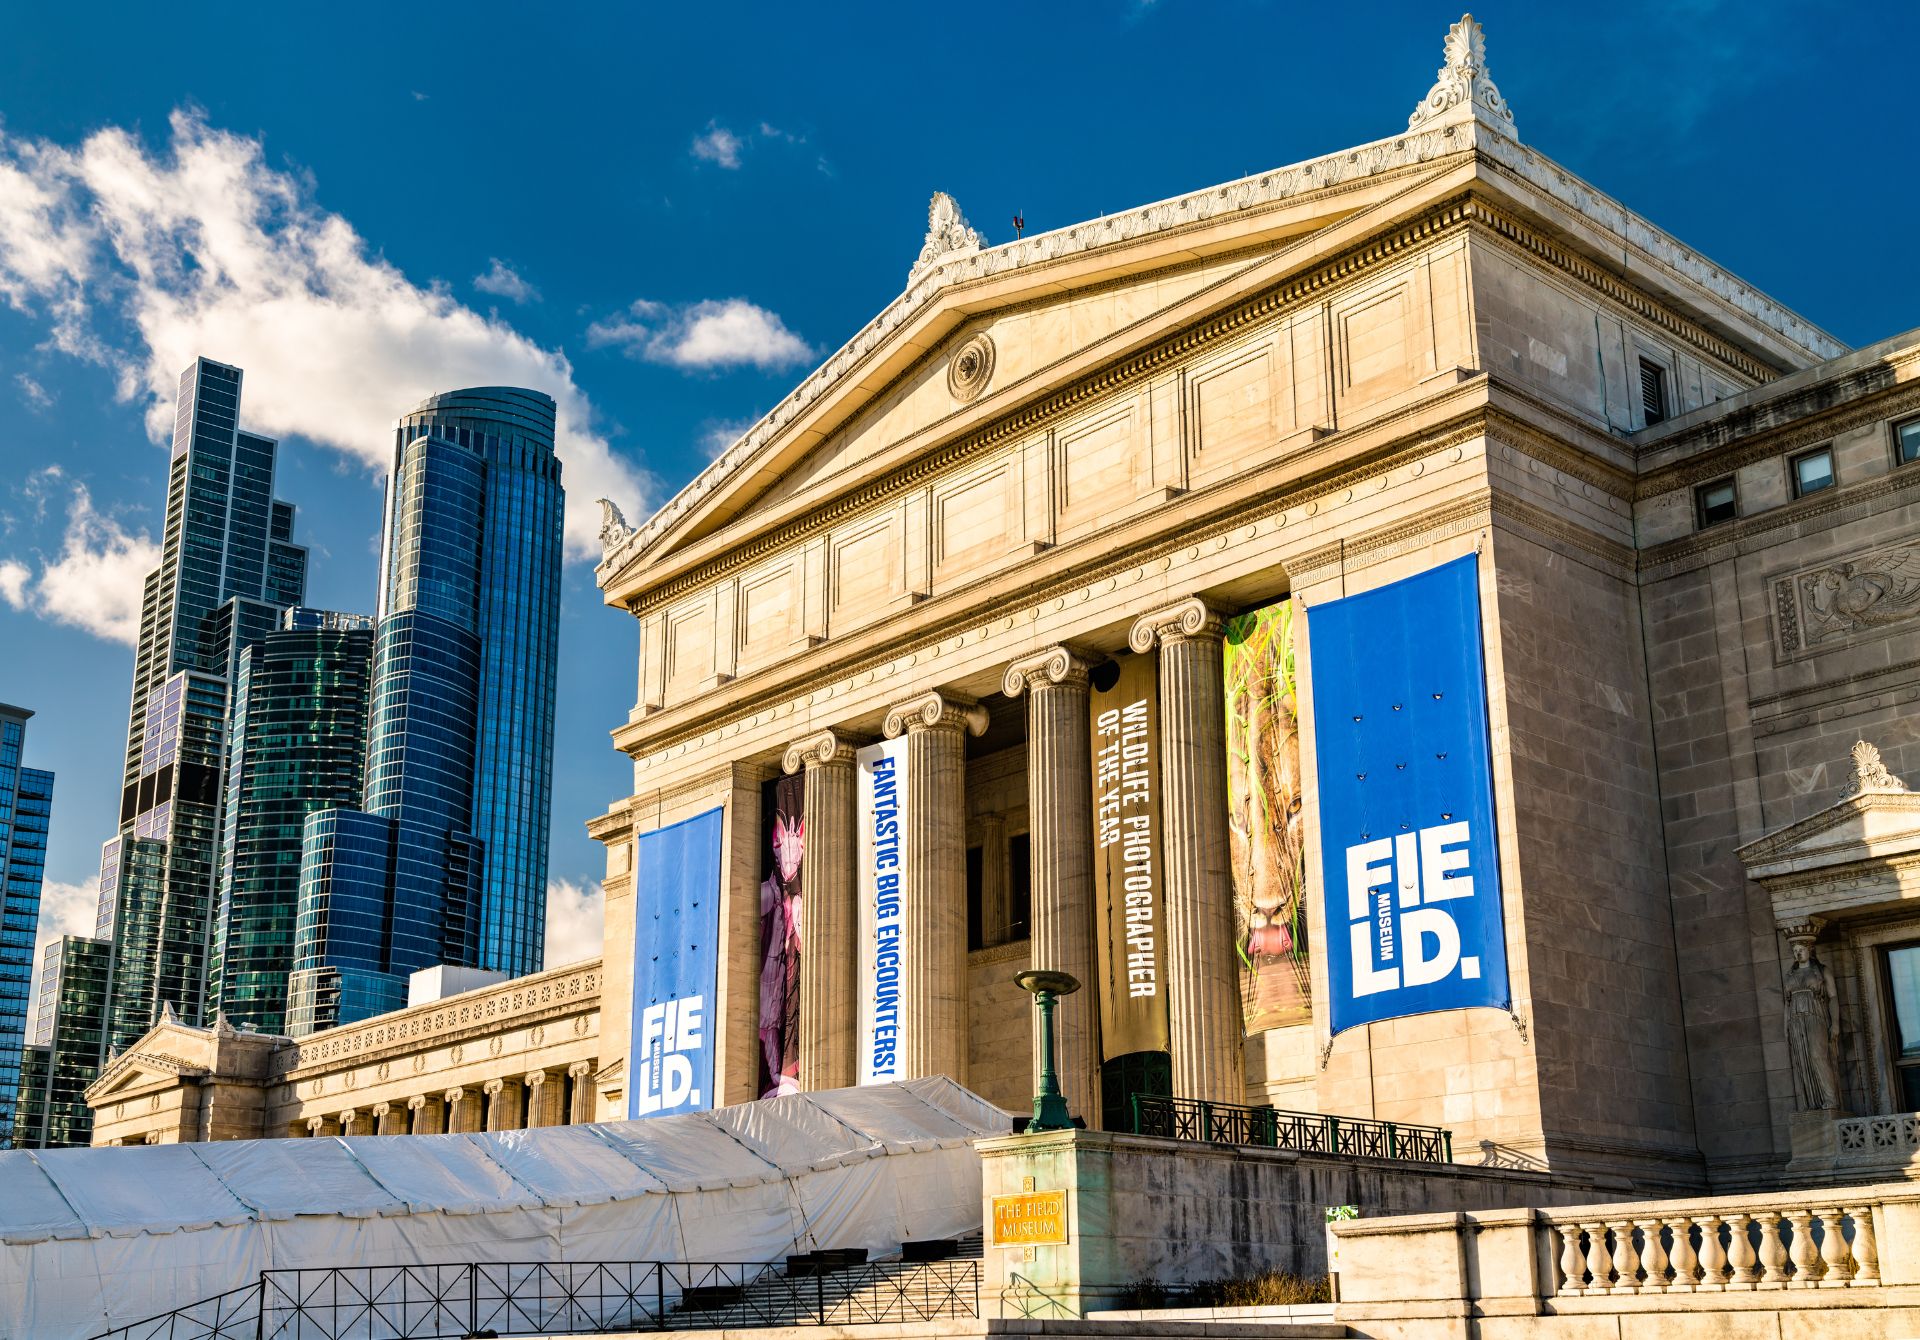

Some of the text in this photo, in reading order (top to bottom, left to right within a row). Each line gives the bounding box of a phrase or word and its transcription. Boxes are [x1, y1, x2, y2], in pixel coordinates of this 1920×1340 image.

[1097, 708, 1120, 849] OF THE YEAR
[1122, 698, 1156, 999] WILDLIFE PHOTOGRAPHER
[872, 756, 900, 1077] FANTASTIC BUG ENCOUNTERS!
[1377, 893, 1394, 961] MUSEUM
[652, 1041, 661, 1090] MUSEUM
[998, 1201, 1060, 1219] THE FIELD
[1003, 1220, 1055, 1237] MUSEUM
